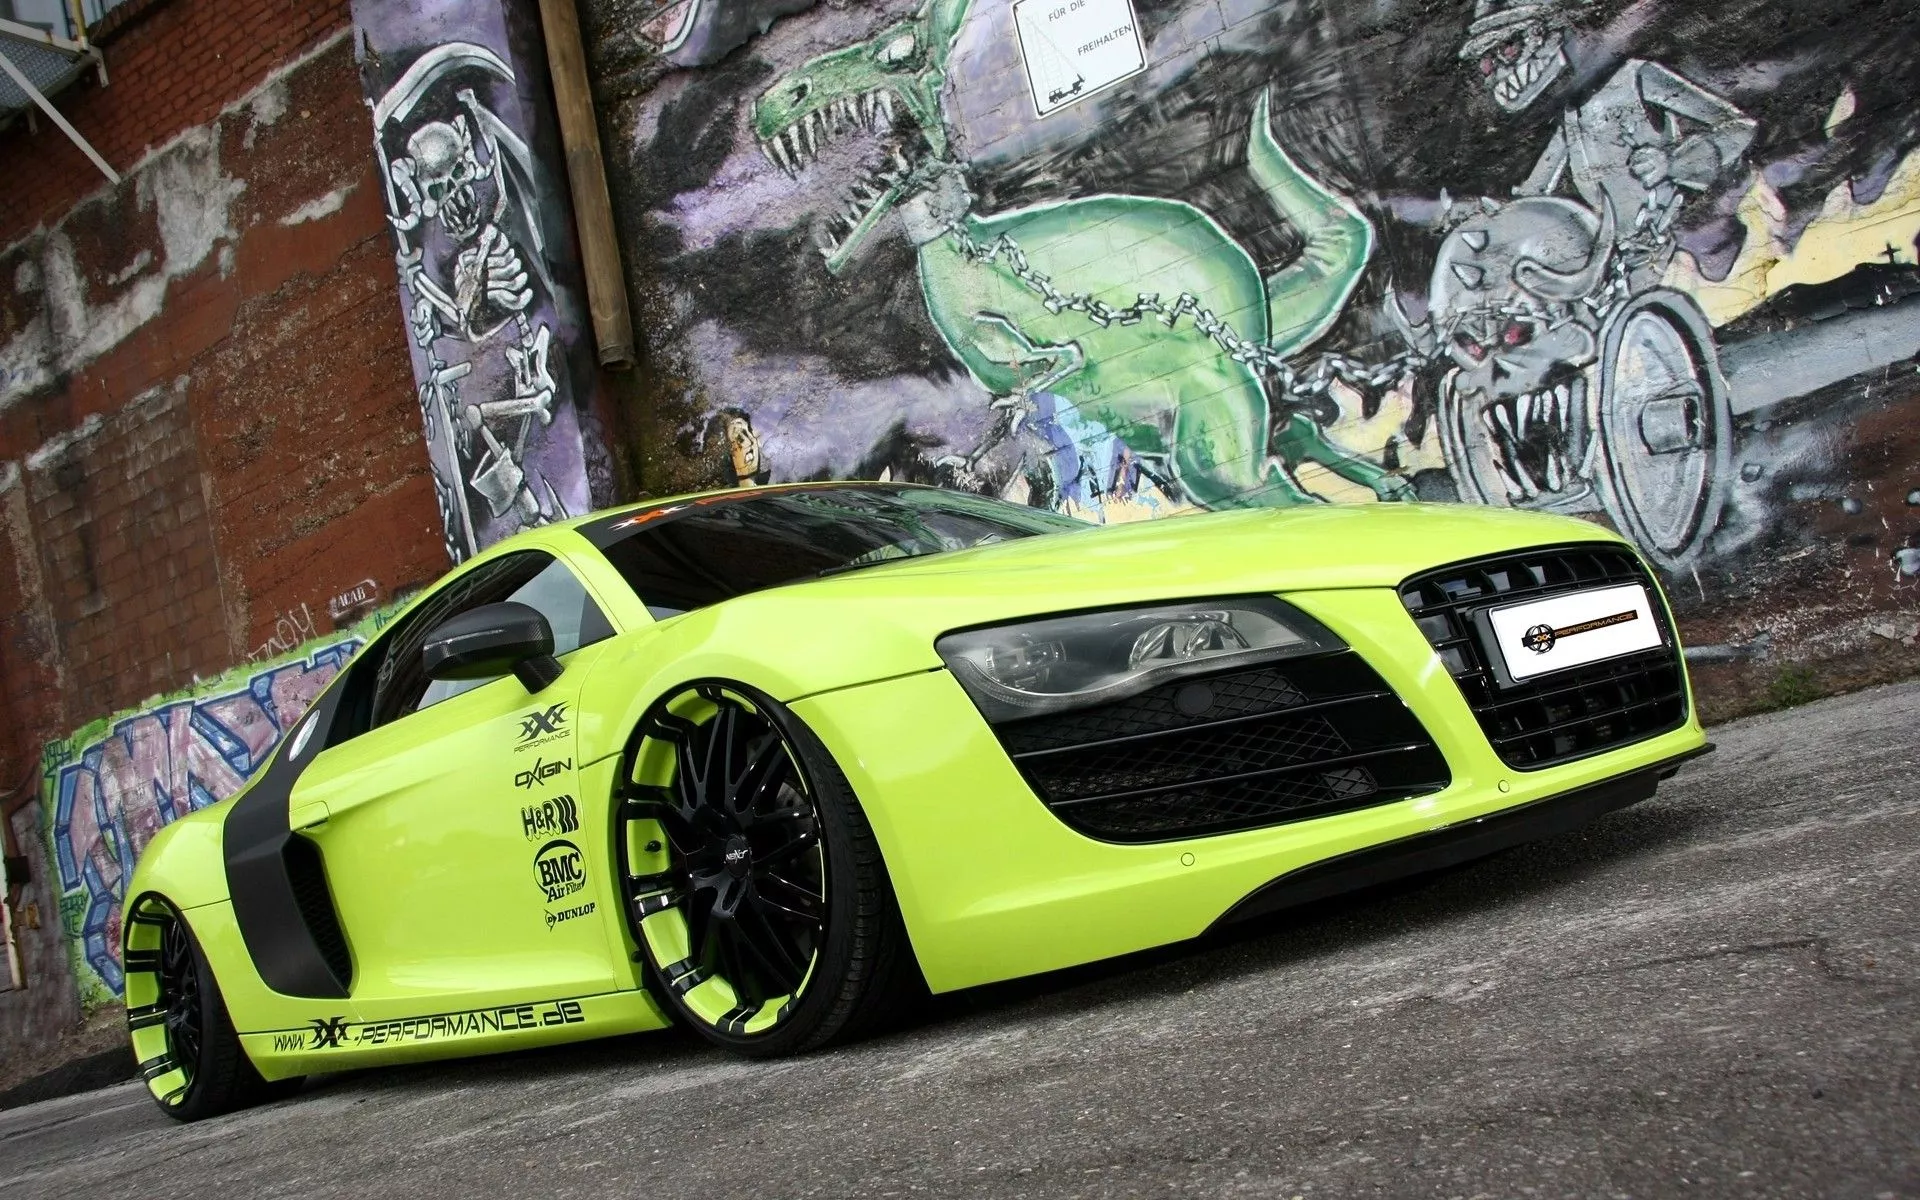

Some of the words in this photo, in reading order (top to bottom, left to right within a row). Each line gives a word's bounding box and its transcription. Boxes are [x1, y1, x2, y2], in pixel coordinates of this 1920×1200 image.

[1048, 7, 1066, 22] FÜR
[1069, 0, 1086, 12] DIE
[1077, 24, 1132, 56] FREIHALTEN
[338, 587, 366, 607] ACAB
[1554, 613, 1634, 638] PERFORMANCE
[513, 729, 571, 754] PERFORMANCE
[521, 800, 561, 842] H&R
[538, 852, 582, 886] BMC
[547, 885, 566, 903] Air
[557, 902, 596, 922] DUNLOP
